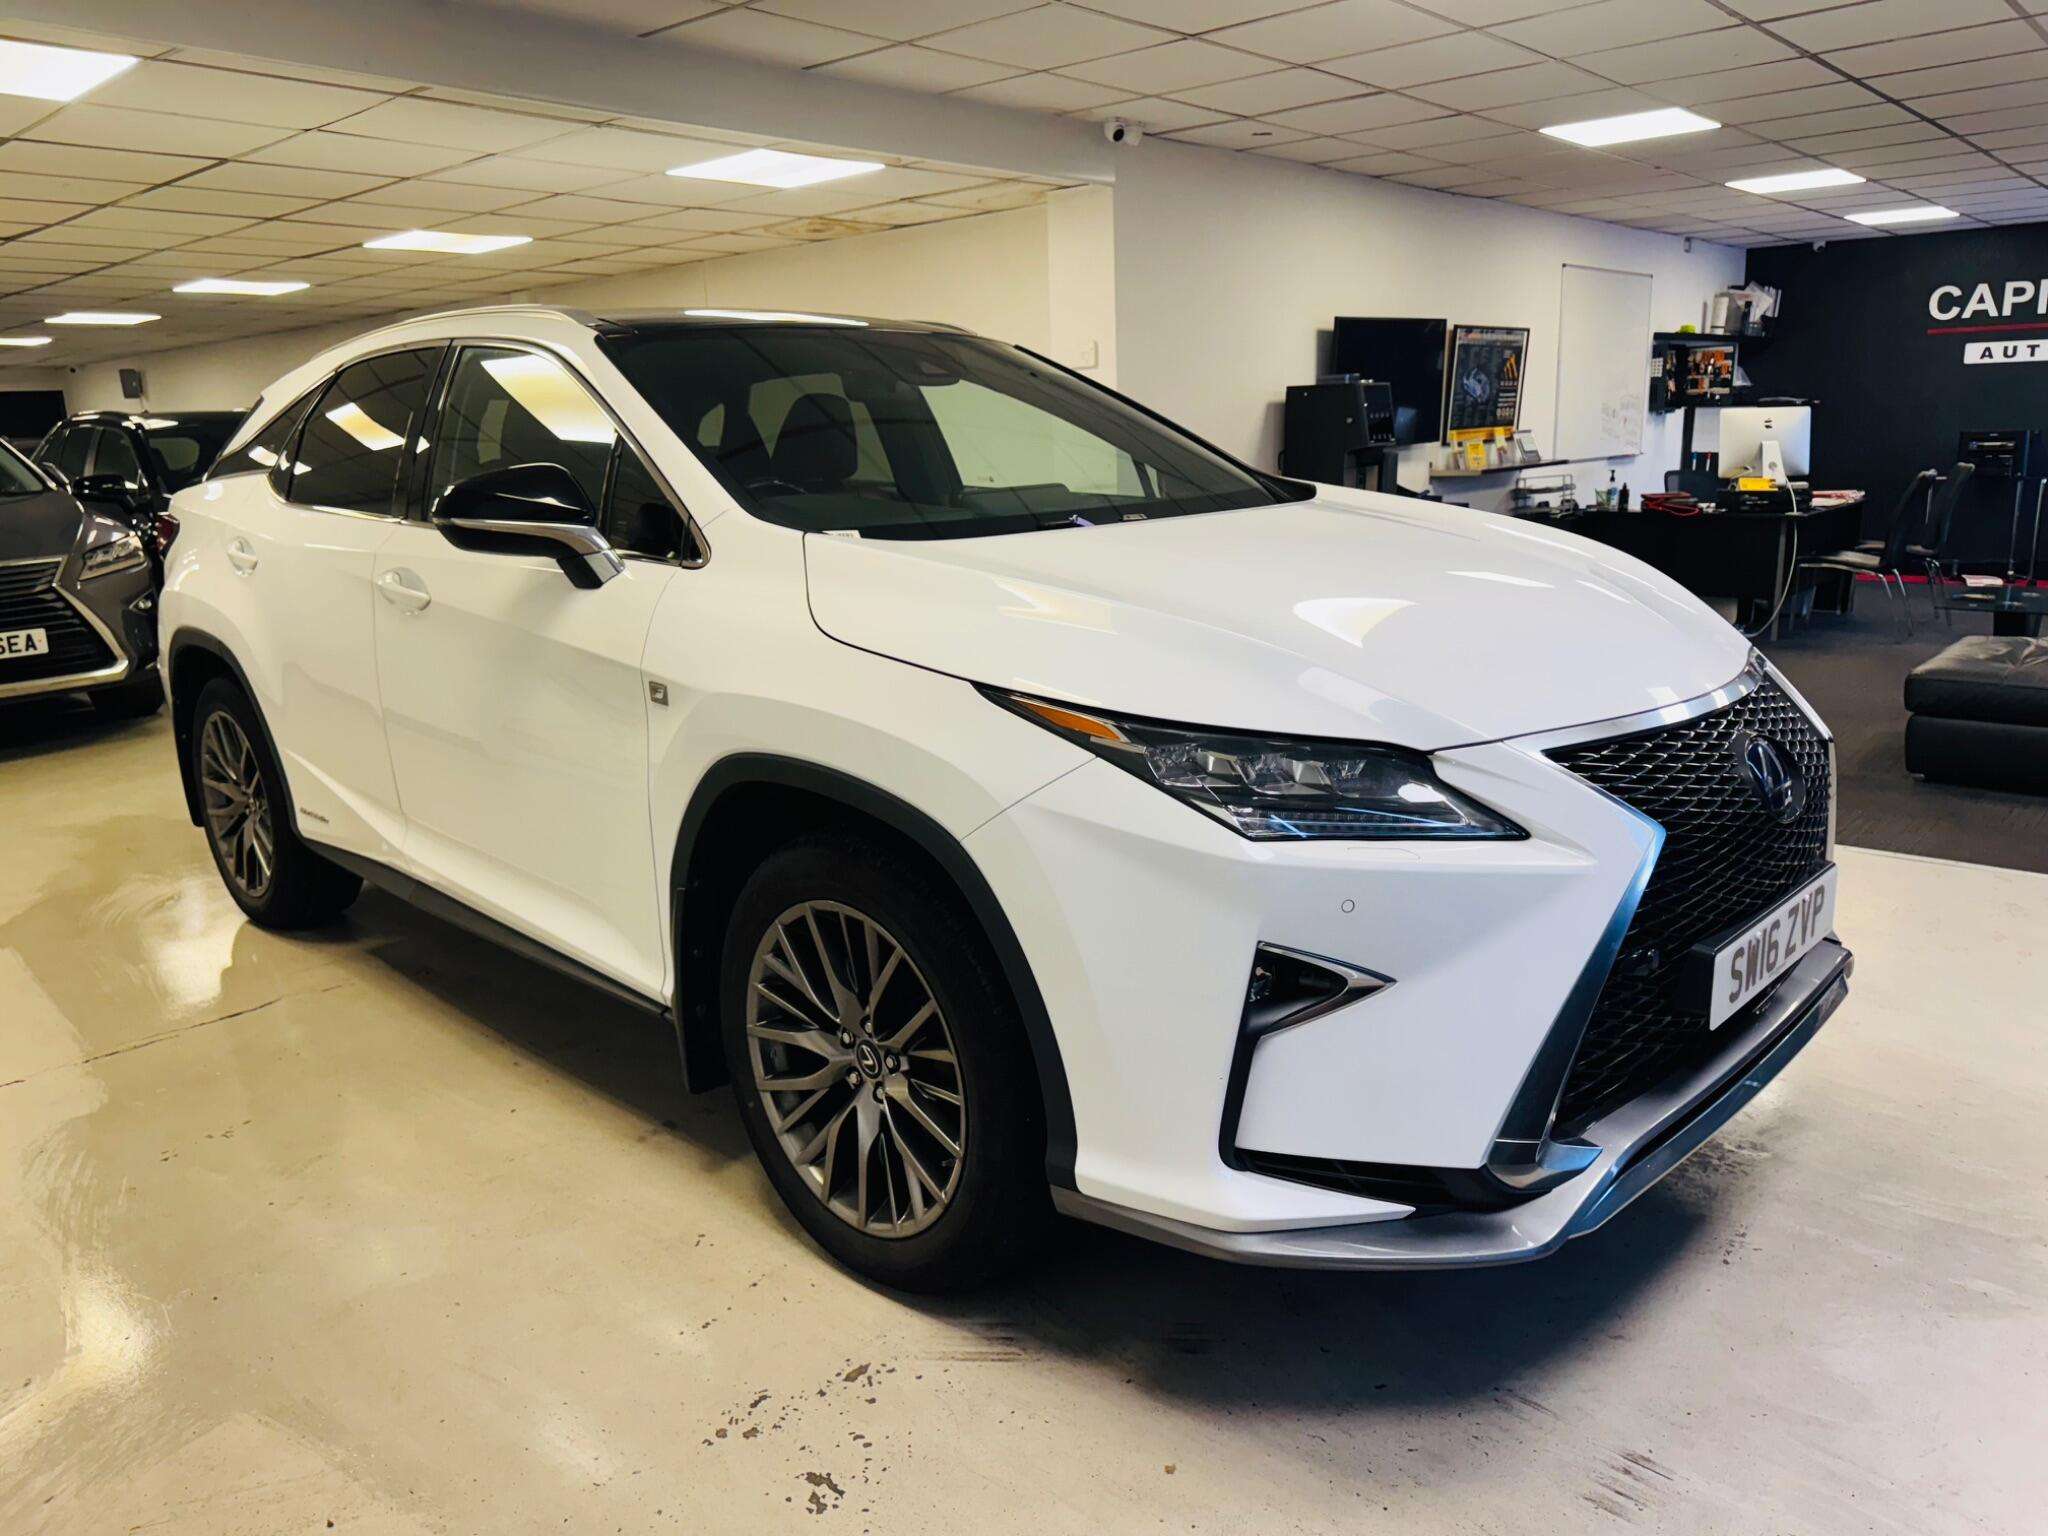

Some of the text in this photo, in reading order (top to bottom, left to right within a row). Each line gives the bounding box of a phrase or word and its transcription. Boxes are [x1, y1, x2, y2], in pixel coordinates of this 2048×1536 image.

[1980, 344, 2040, 359] AUT
[1729, 884, 1825, 1004] SW16 ZVP
